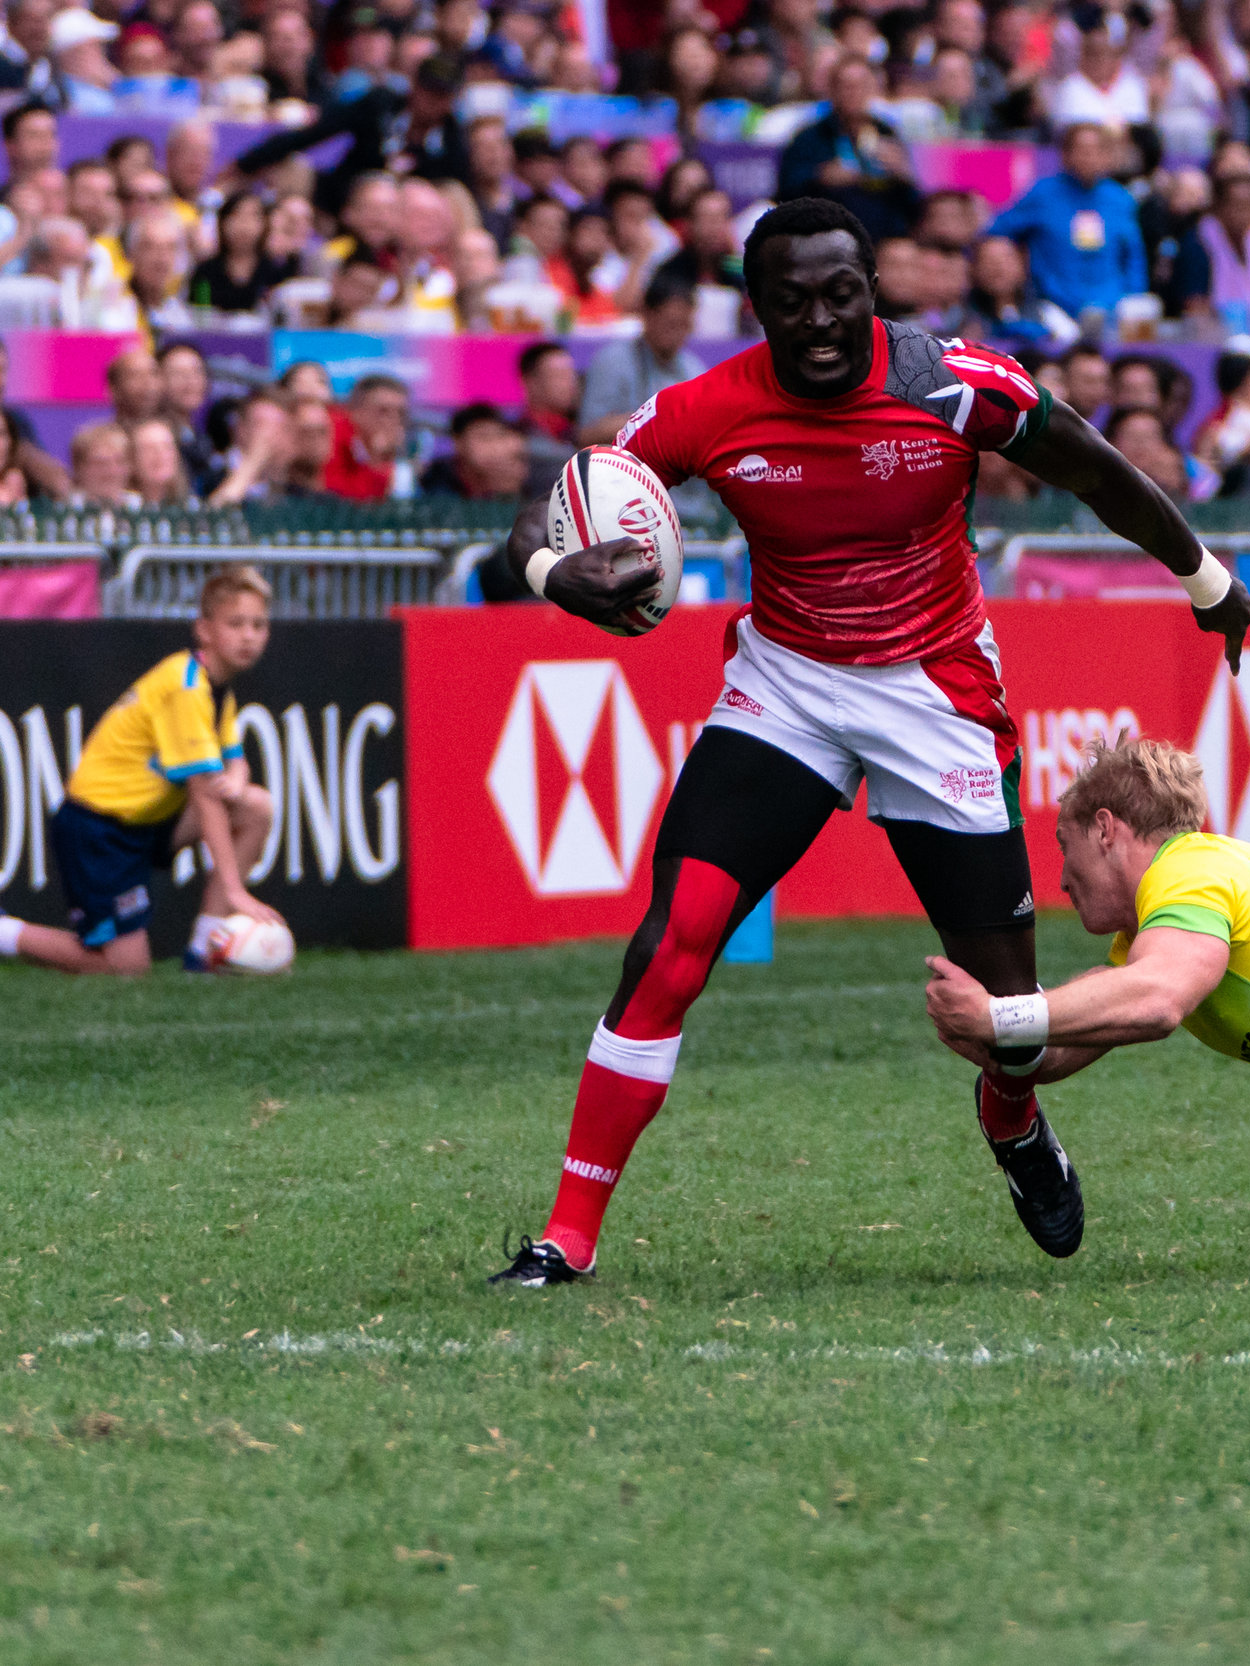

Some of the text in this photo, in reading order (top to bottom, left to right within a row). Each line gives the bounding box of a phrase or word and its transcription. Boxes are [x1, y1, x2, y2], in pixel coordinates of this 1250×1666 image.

[901, 438, 938, 449] Kenya
[903, 448, 942, 461] Rugby
[906, 459, 943, 472] Union
[967, 769, 994, 778] Kenya
[969, 778, 995, 788] Rugby
[173, 702, 400, 888] ONG
[971, 789, 995, 799] Union
